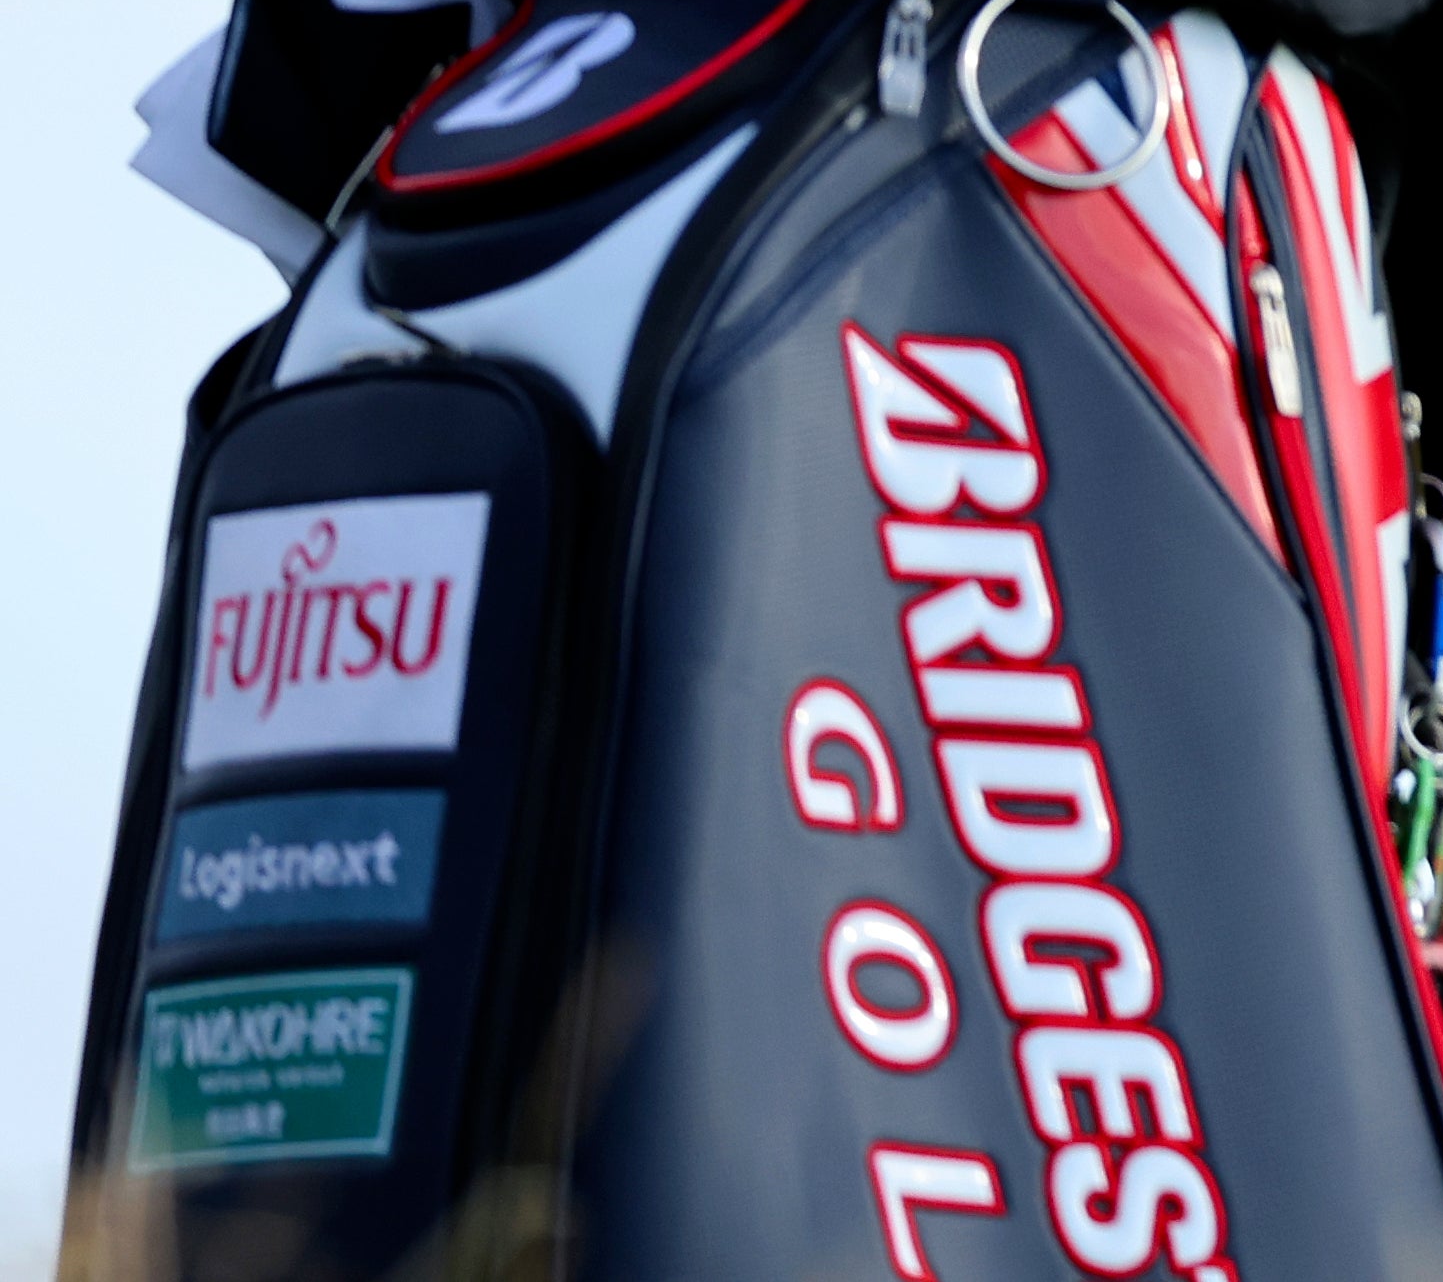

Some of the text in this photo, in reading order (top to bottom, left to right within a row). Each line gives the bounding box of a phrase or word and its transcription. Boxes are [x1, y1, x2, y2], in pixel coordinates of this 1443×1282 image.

[204, 517, 456, 721] FUJITSU
[180, 833, 398, 910] Logisnext
[841, 317, 1238, 1282] BRIDGES
